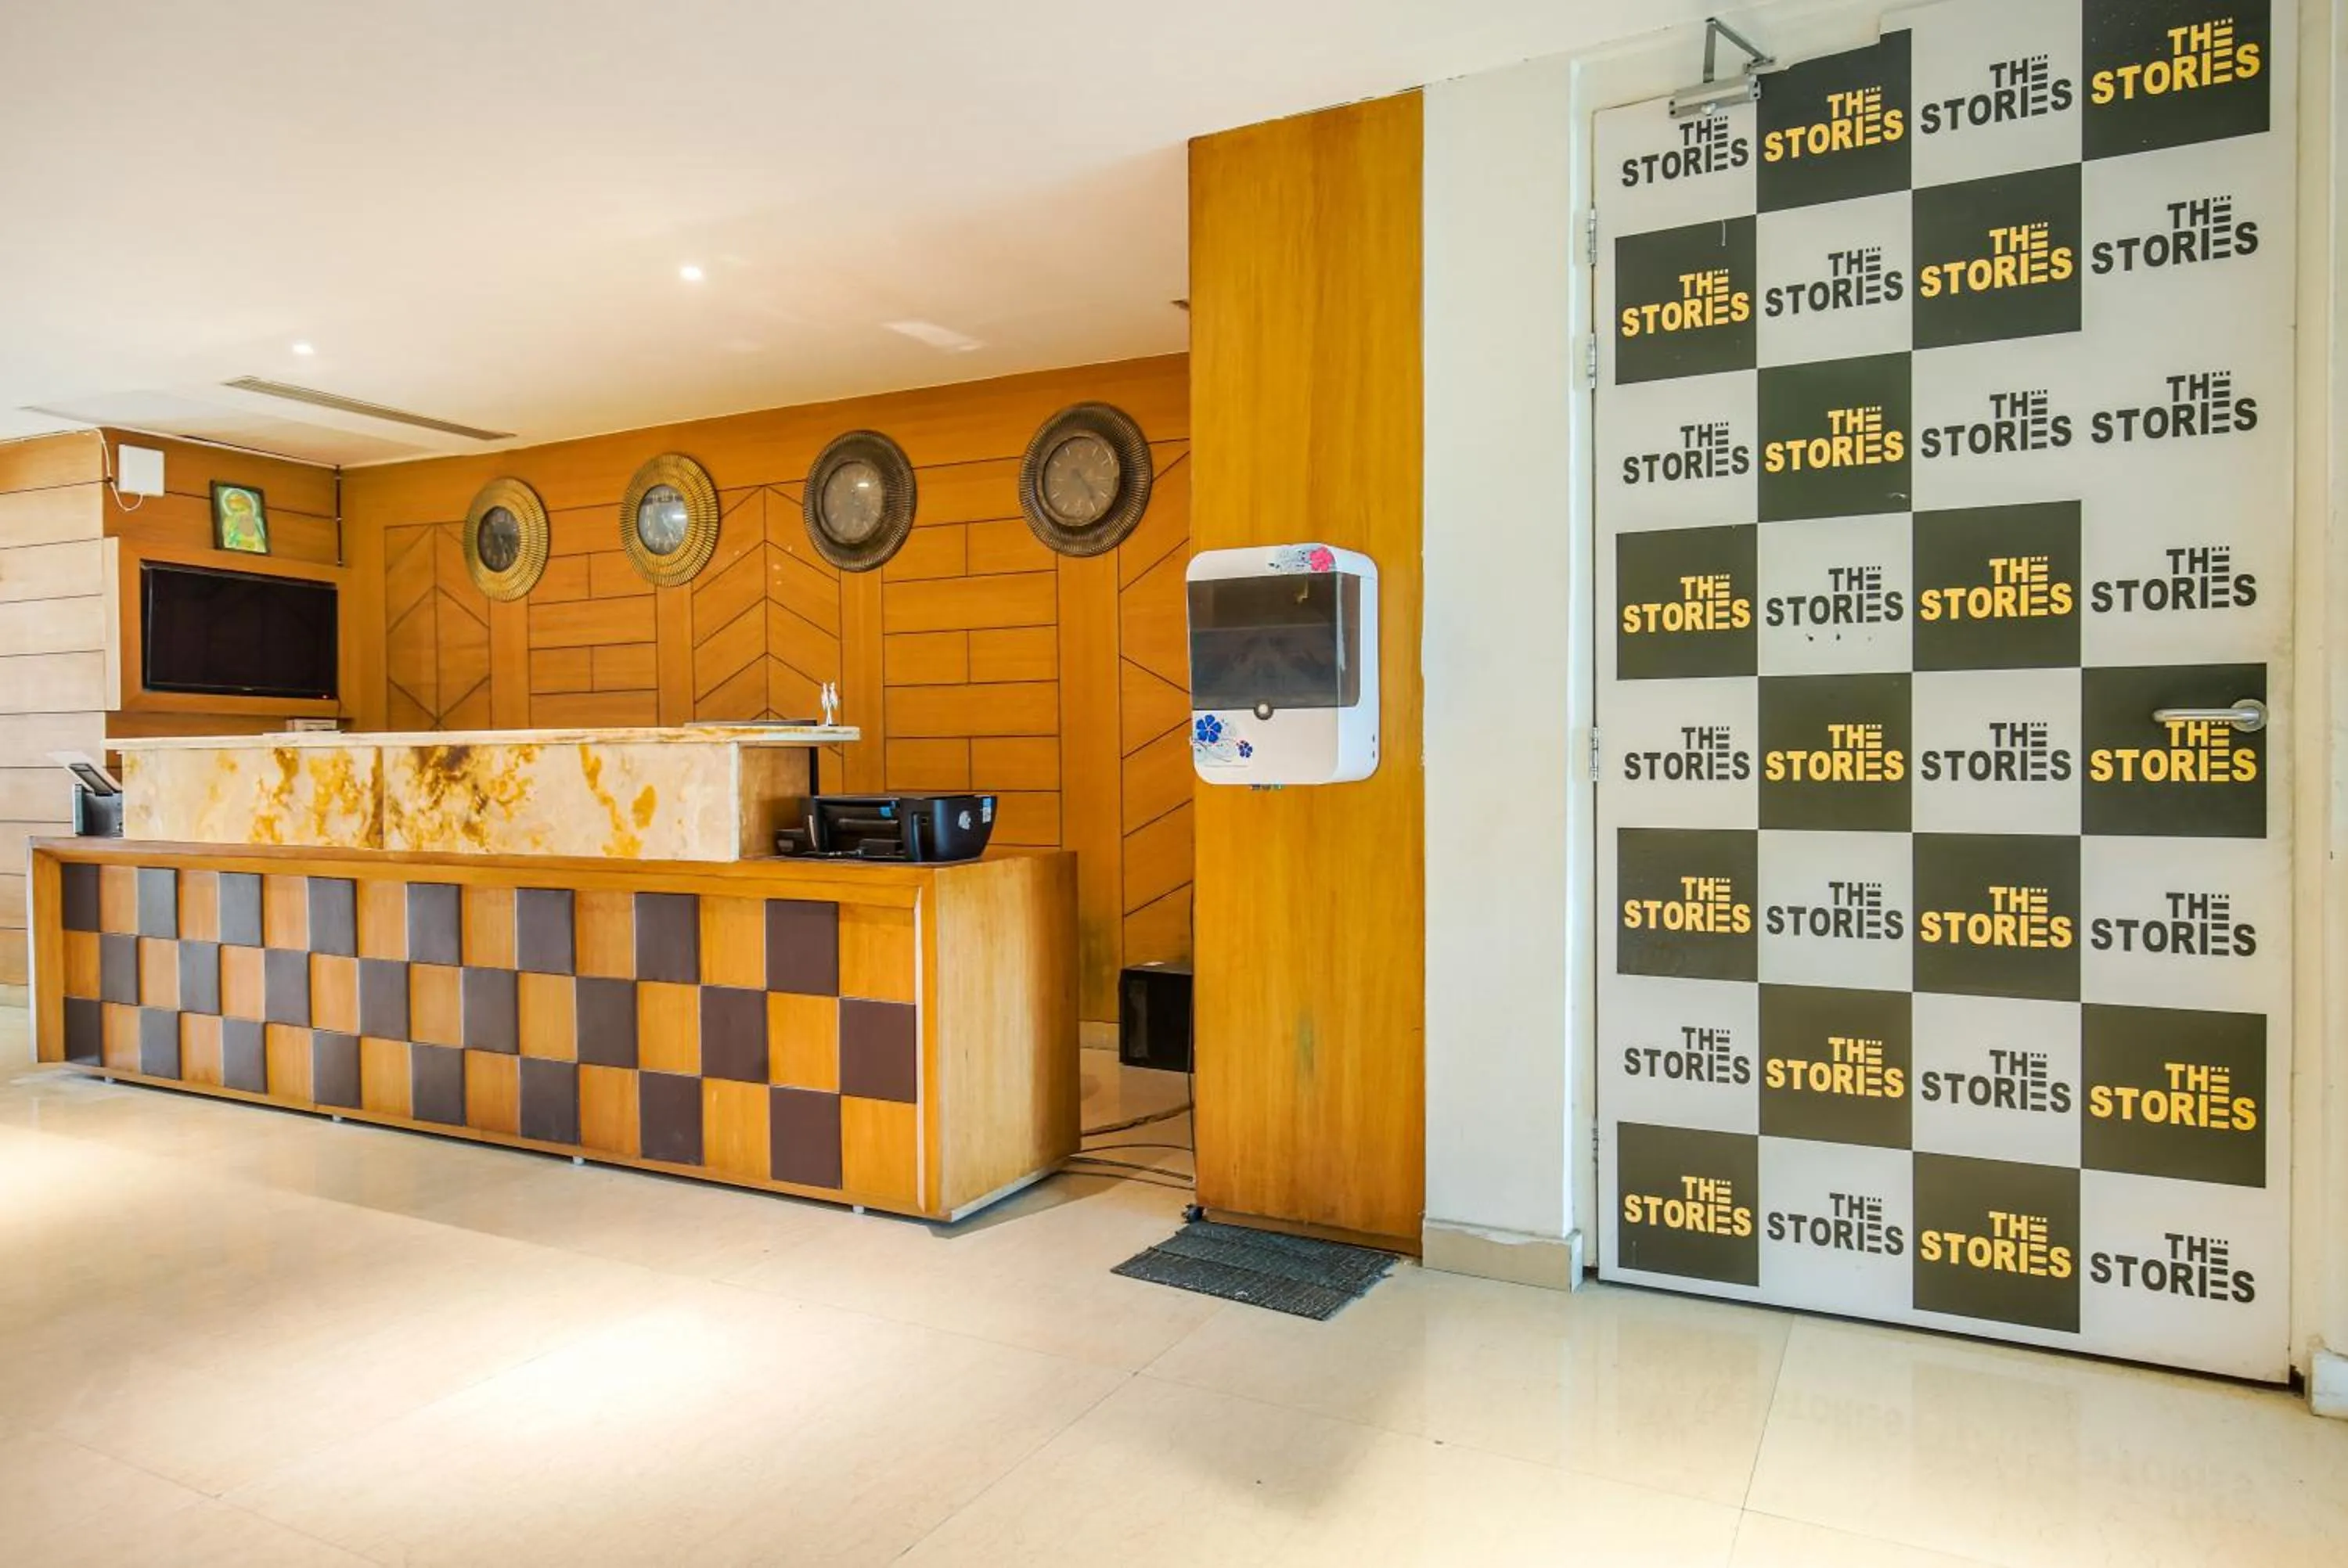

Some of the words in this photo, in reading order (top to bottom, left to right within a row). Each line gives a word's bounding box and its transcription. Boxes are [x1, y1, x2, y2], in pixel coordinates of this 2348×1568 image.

[2167, 18, 2233, 56] THE
[1990, 54, 2047, 88] THE
[2091, 44, 2260, 104] STORIES
[1827, 86, 1881, 119] THE
[1921, 79, 2073, 135] STORIES
[1679, 116, 1728, 146] THE
[1764, 110, 1903, 162] STORIES
[1622, 138, 1748, 187] STORIES
[2167, 195, 2231, 229] THE
[1989, 222, 2047, 254] THE
[2091, 221, 2258, 274] STORIES
[1828, 246, 1881, 277] THE
[1921, 247, 2073, 297] STORIES
[1679, 269, 1729, 298] THE
[1765, 271, 1903, 317] STORIES
[1622, 292, 1749, 336] STORIES
[2166, 371, 2231, 402] THE
[1828, 406, 1882, 435] THE
[1990, 390, 2047, 419] THE
[2091, 397, 2257, 444] STORIES
[1680, 422, 1729, 448] THE
[1765, 431, 1903, 472] STORIES
[1921, 415, 2072, 459] STORIES
[1623, 446, 1749, 484] STORIES
[1990, 556, 2047, 584] THE
[2166, 546, 2230, 575] THE
[1680, 574, 1730, 600] THE
[1828, 566, 1882, 592] THE
[2091, 574, 2256, 613] STORIES
[1623, 599, 1751, 633] STORIES
[1766, 592, 1903, 627] STORIES
[1921, 583, 2073, 620] STORIES
[1681, 726, 1730, 750] THE
[1828, 725, 1882, 749] THE
[1990, 722, 2047, 748] THE
[2165, 720, 2230, 746] THE
[1624, 751, 1750, 780] STORIES
[1766, 750, 1904, 781] STORIES
[1921, 750, 2071, 781] STORIES
[2091, 749, 2256, 782] STORIES
[1681, 876, 1730, 901] THE
[1828, 882, 1882, 907] THE
[1989, 886, 2047, 914] THE
[1624, 900, 1751, 933] STORIES
[1766, 905, 1903, 940] STORIES
[2166, 892, 2229, 921] THE
[1921, 912, 2072, 948] STORIES
[2091, 919, 2256, 956] STORIES
[1681, 1027, 1730, 1052] THE
[1828, 1037, 1882, 1065] THE
[1624, 1048, 1750, 1084] STORIES
[1766, 1059, 1904, 1098] STORIES
[1990, 1049, 2047, 1078] THE
[2165, 1063, 2229, 1094] THE
[1921, 1071, 2071, 1113] STORIES
[2090, 1085, 2256, 1131] STORIES
[1681, 1176, 1731, 1204] THE
[1829, 1192, 1882, 1221] THE
[1625, 1194, 1752, 1236] STORIES
[1989, 1211, 2047, 1243] THE
[1767, 1212, 1903, 1256] STORIES
[2165, 1233, 2228, 1266] THE
[1921, 1230, 2071, 1278] STORIES
[2091, 1252, 2255, 1303] STORIES
